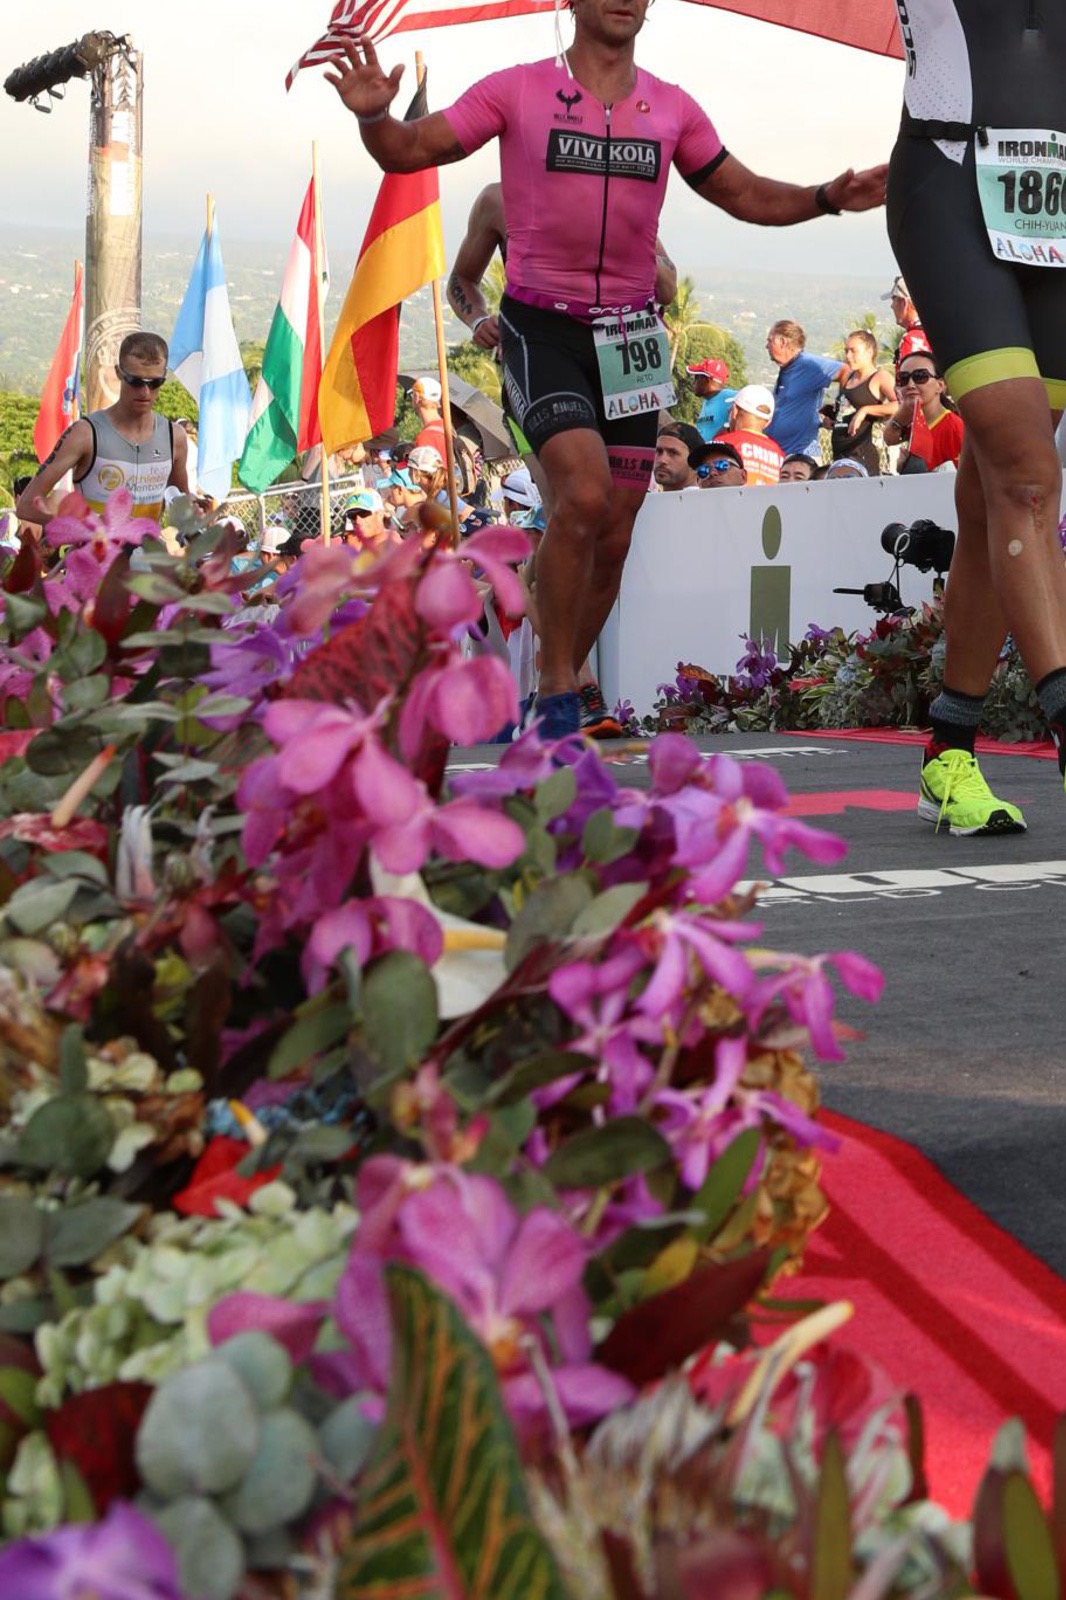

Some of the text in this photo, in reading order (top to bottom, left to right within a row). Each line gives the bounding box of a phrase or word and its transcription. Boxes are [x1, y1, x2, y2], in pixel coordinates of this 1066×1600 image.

[558, 137, 656, 165] VIVI KOLA
[996, 237, 1065, 264] ALOHA
[615, 337, 662, 375] 798
[607, 392, 660, 418] ALOHA
[741, 442, 784, 467] CHIN
